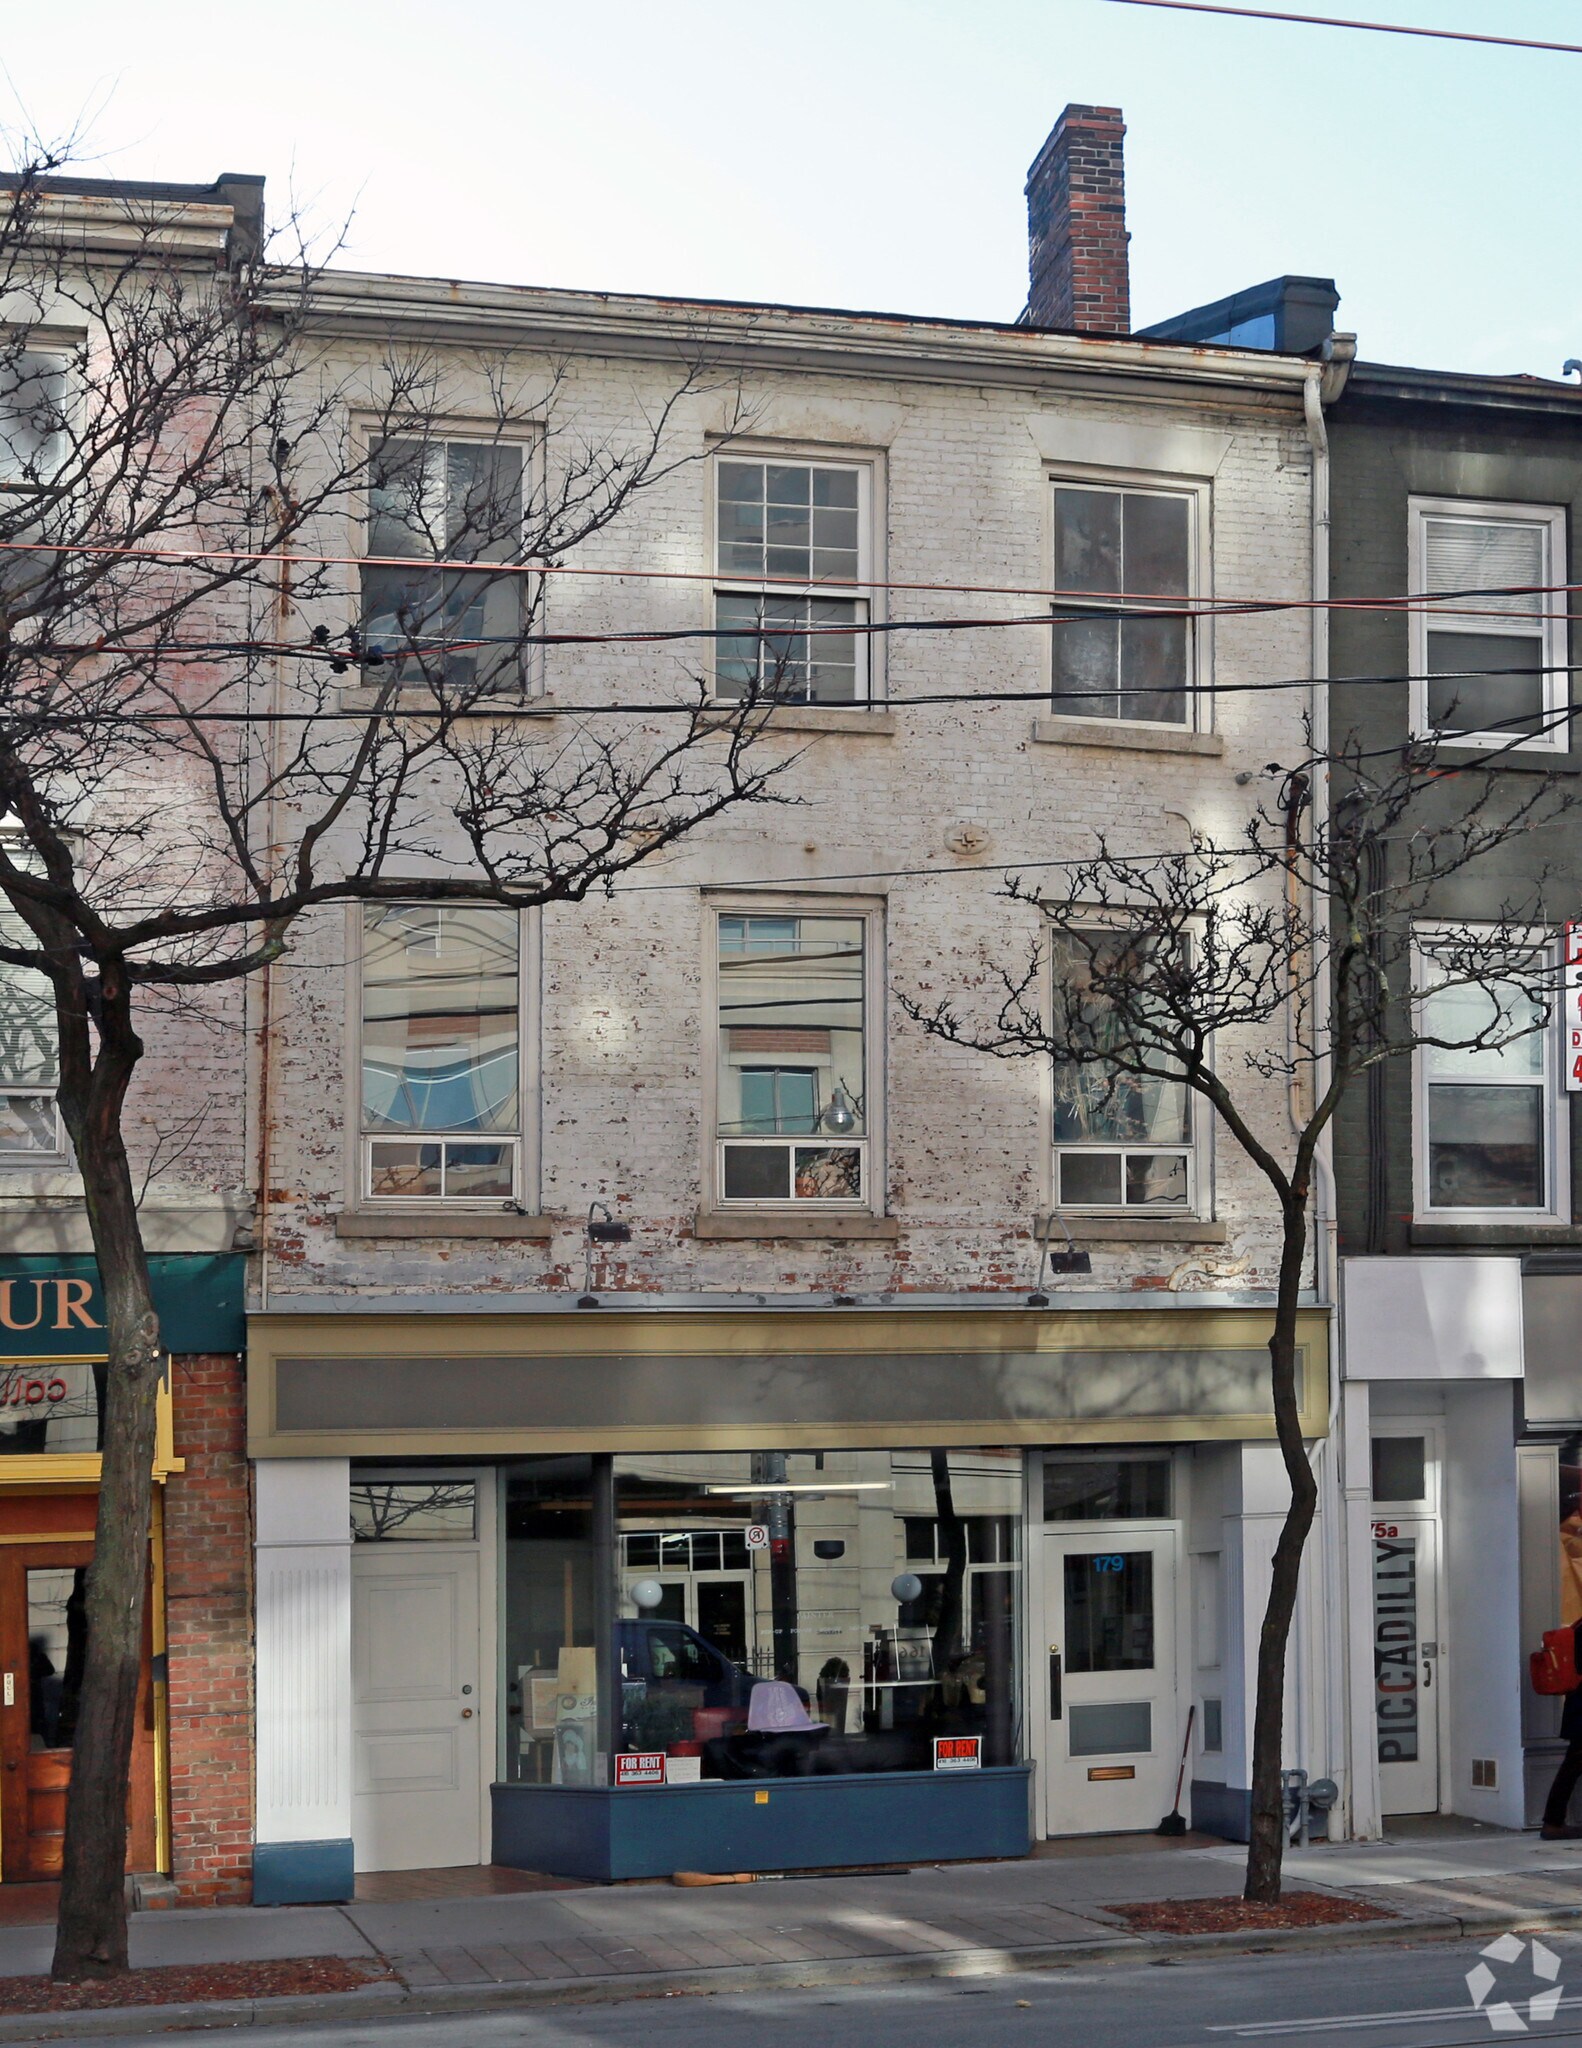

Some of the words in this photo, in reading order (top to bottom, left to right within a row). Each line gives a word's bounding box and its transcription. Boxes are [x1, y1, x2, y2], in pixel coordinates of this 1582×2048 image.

[0, 1278, 107, 1330] UR
[1093, 1555, 1124, 1572] 179
[1377, 1541, 1418, 1763] PICCADILLY
[938, 1741, 953, 1758] FOR
[956, 1739, 977, 1757] RENT
[621, 1757, 638, 1770] FOR
[639, 1756, 661, 1769] RENT
